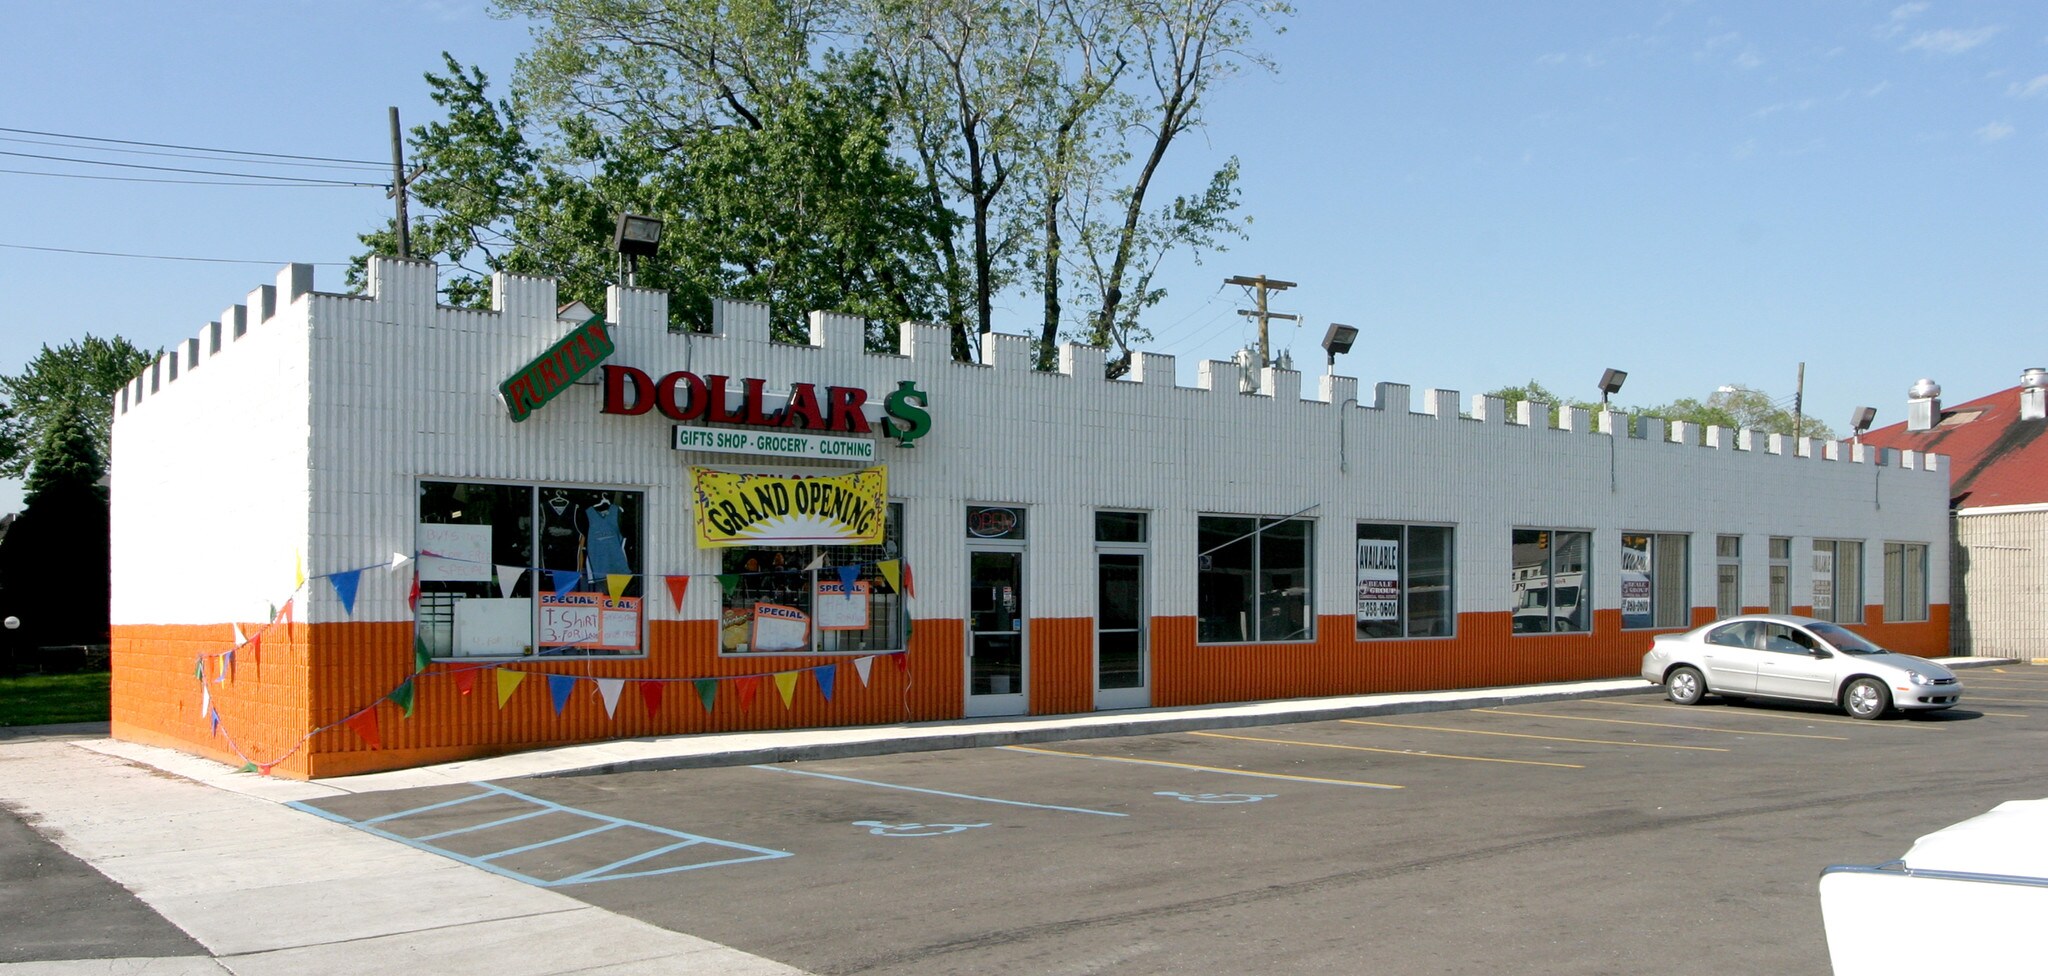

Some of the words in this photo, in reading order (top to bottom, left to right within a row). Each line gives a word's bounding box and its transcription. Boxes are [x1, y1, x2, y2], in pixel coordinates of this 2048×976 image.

[508, 320, 611, 416] PURITAN
[600, 365, 873, 433] DOLLAR
[880, 380, 932, 448] $
[680, 430, 714, 448] GIFTS
[717, 432, 748, 449] SHOP
[757, 435, 808, 453] GROCERY
[819, 439, 872, 457] CLOTHING
[708, 482, 790, 536] GRAND
[795, 481, 875, 535] OPENING
[968, 512, 1013, 532] OPEN
[1360, 545, 1396, 570] AVAILABLE
[542, 595, 598, 604] SPECIAL!
[819, 584, 865, 593] SPECAL!
[1369, 587, 1397, 595] GROUP
